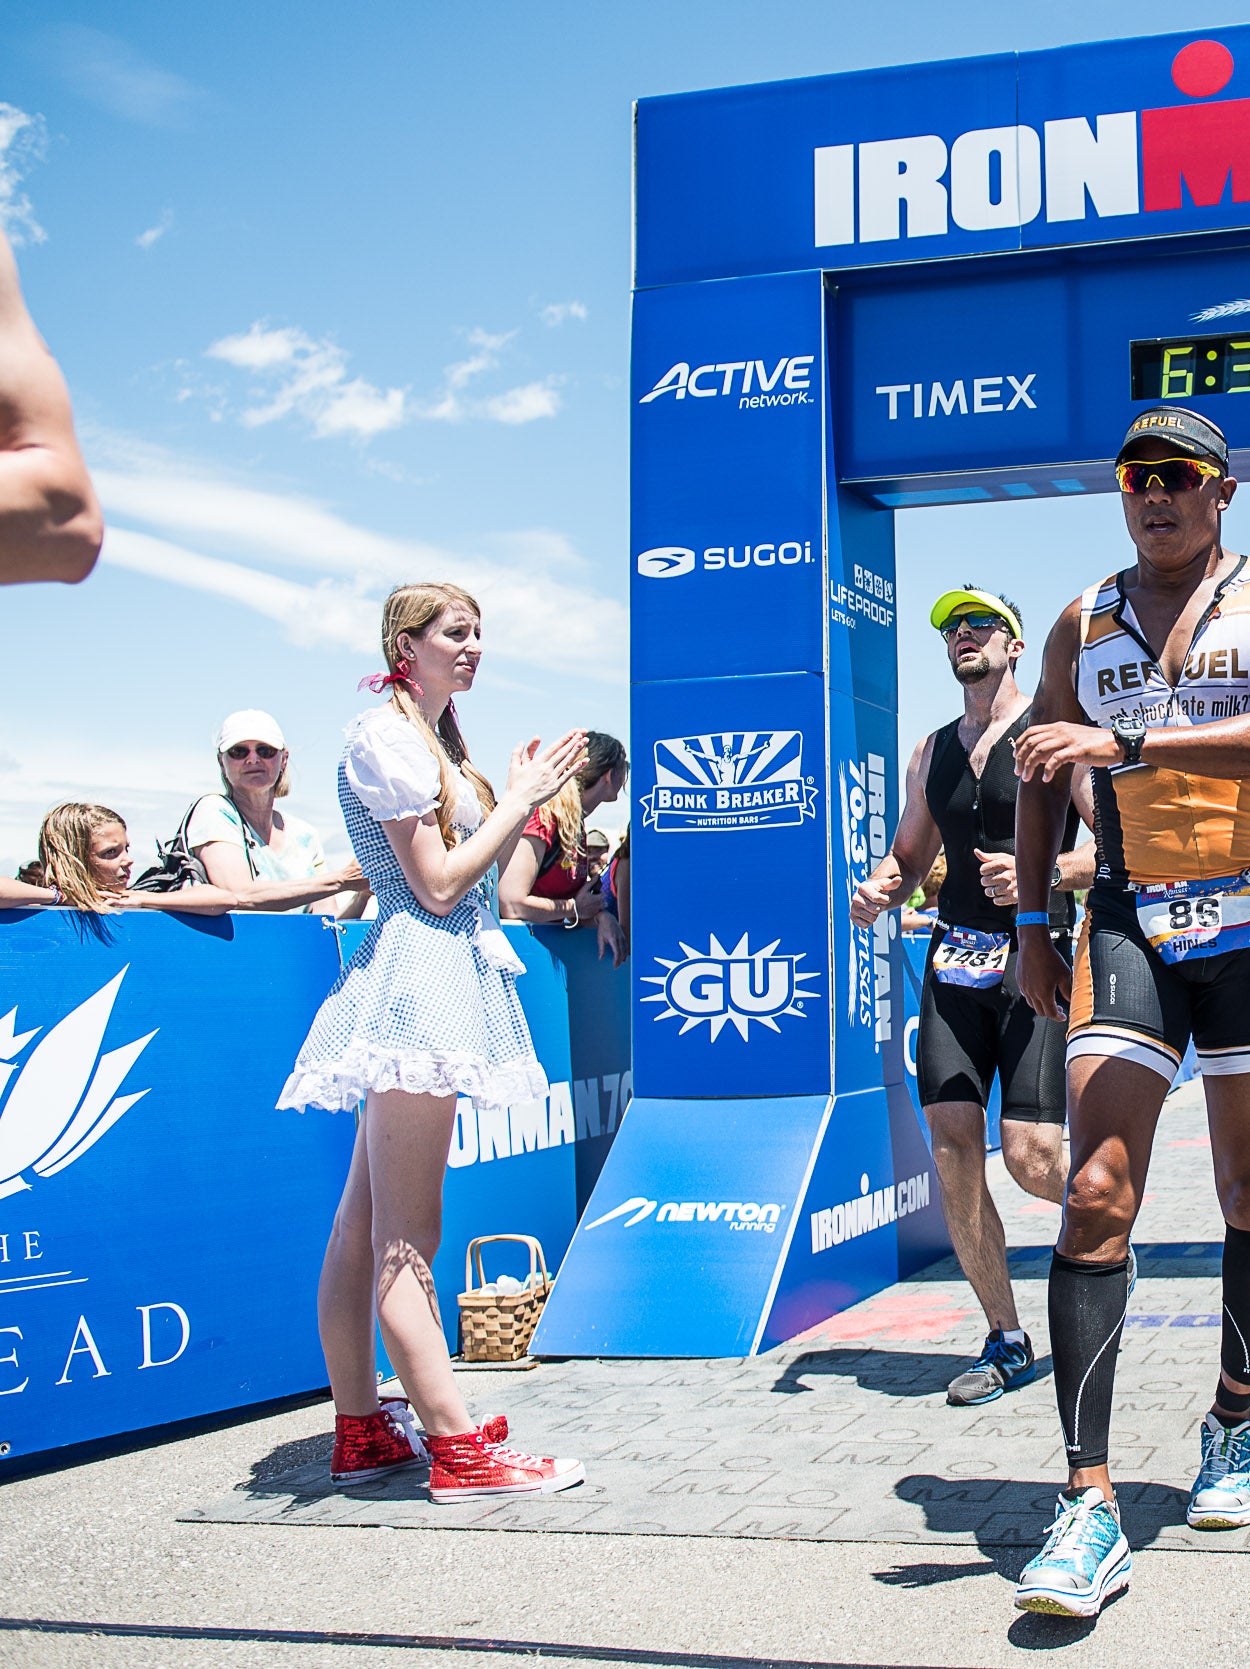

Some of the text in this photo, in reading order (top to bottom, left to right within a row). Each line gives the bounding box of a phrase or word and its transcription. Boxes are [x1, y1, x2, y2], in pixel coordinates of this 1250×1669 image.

[639, 355, 815, 404] ACTIVE
[739, 391, 808, 409] network
[876, 373, 1037, 420] TIMEX
[1132, 416, 1186, 432] REFUEL
[830, 579, 894, 628] LIFEPROOF
[658, 782, 800, 809] BONK BREAKER
[697, 815, 759, 826] NUTRITION BARS
[1168, 897, 1220, 930] 86
[943, 946, 1004, 968] 1481
[1173, 937, 1218, 953] HINES
[668, 957, 791, 1014] GU
[729, 1220, 777, 1234] running
[810, 1172, 930, 1255] IRONMAN.COM
[0, 1301, 191, 1397] EAD
